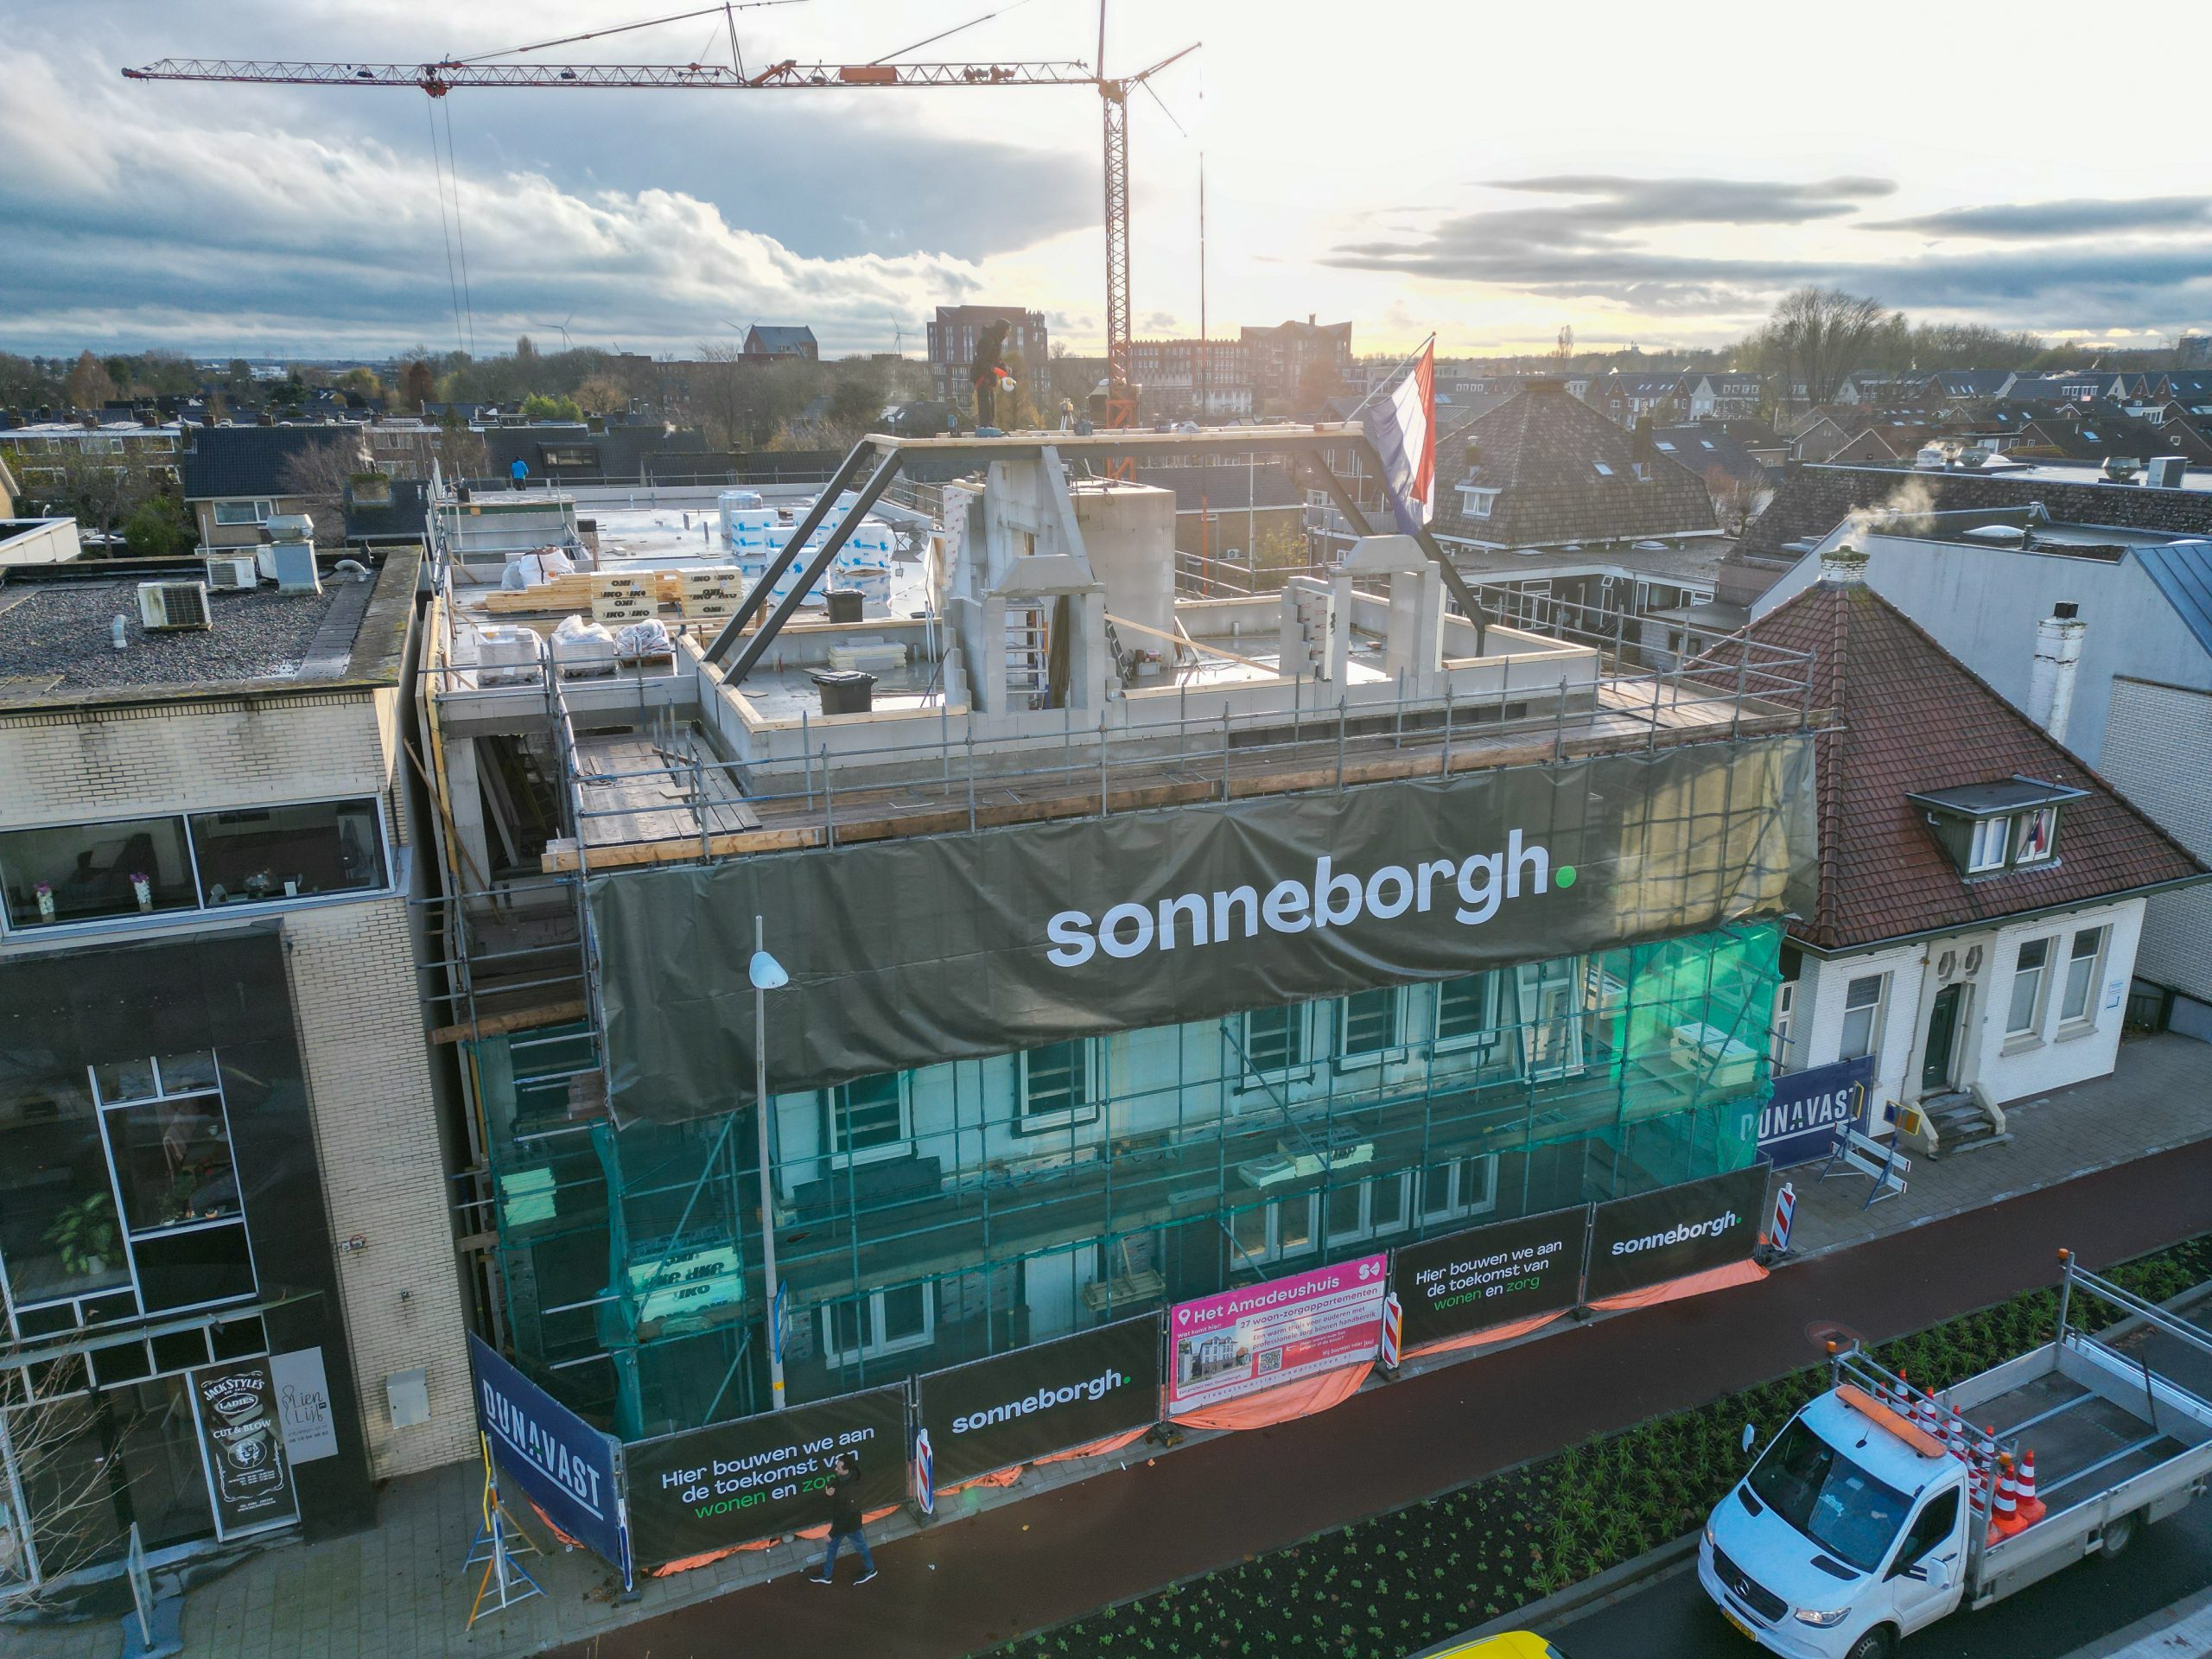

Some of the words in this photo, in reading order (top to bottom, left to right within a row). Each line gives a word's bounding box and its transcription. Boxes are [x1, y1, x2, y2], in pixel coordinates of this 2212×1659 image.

[1046, 828, 1577, 968] sonneborgh.
[1741, 1087, 1854, 1141] DUNAVAS
[1611, 1211, 1743, 1255] sonneborgh.
[1415, 1268, 1446, 1285] Hier
[1450, 1253, 1507, 1275] bouwen
[1512, 1248, 1533, 1261] we
[1537, 1241, 1562, 1255] aan
[1427, 1283, 1445, 1298] de
[1449, 1264, 1520, 1291] toekomst
[1523, 1259, 1549, 1272] van
[1194, 1306, 1224, 1324] Het
[1227, 1276, 1340, 1315] Amadeushuis
[1239, 1319, 1250, 1328] 27
[1253, 1287, 1377, 1325] woon-zorgappartementen
[1434, 1289, 1482, 1311] wonen
[1485, 1284, 1503, 1297] en
[1507, 1276, 1540, 1293] zorg
[1252, 1332, 1266, 1341] Een
[1267, 1328, 1287, 1337] warm
[1287, 1321, 1305, 1331] thuis
[1322, 1309, 1351, 1322] ouderen
[1252, 1332, 1298, 1350] professionele
[1299, 1329, 1313, 1338] zorg
[1314, 1321, 1338, 1332] binnen
[1338, 1310, 1376, 1325] handbereik
[220, 1396, 255, 1410] LADIES
[952, 1369, 1131, 1433] sonneborgh.
[213, 1427, 232, 1439] CUT
[233, 1426, 242, 1434] &
[243, 1419, 271, 1433] BLOW
[483, 1379, 600, 1508] DUNAVAST
[662, 1465, 708, 1489] Hier
[713, 1445, 798, 1476] bouwen
[803, 1436, 834, 1454] we
[839, 1427, 874, 1446] aan
[682, 1485, 709, 1503] de
[715, 1458, 817, 1495] toekomst
[695, 1492, 766, 1519] wonen
[772, 1483, 797, 1499] en
[803, 1473, 836, 1493] zor
